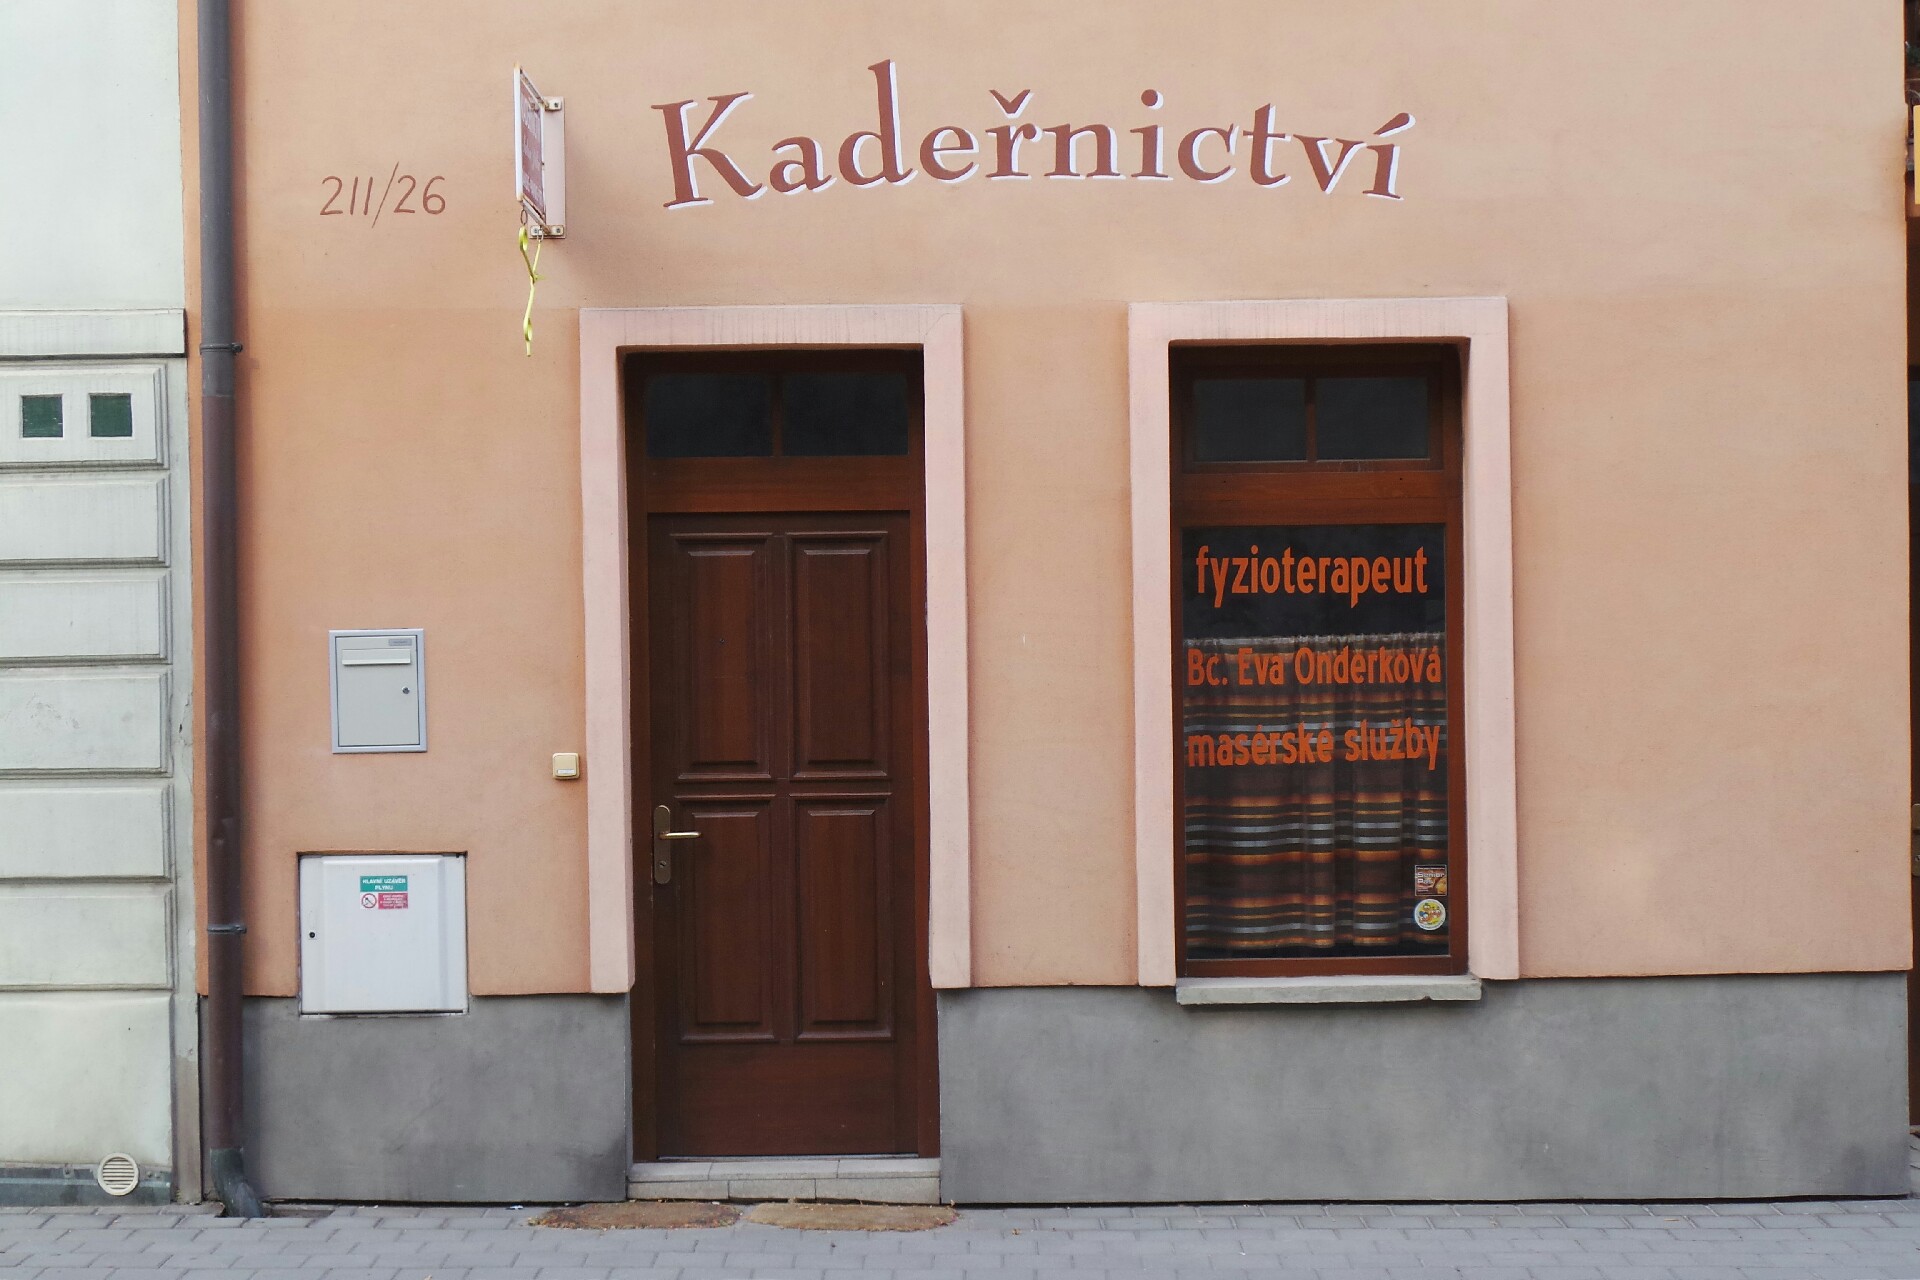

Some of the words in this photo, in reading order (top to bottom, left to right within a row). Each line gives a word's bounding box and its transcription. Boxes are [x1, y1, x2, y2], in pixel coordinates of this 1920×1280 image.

[651, 59, 1416, 209] Kadeřnictví
[319, 161, 446, 228] 211/26
[1196, 545, 1428, 608] fyzioterapeut
[1187, 647, 1228, 686] Bc.
[1238, 648, 1285, 685] Eva
[1294, 645, 1442, 685] Onderková
[1187, 721, 1335, 767] masérské
[1344, 715, 1440, 771] služby
